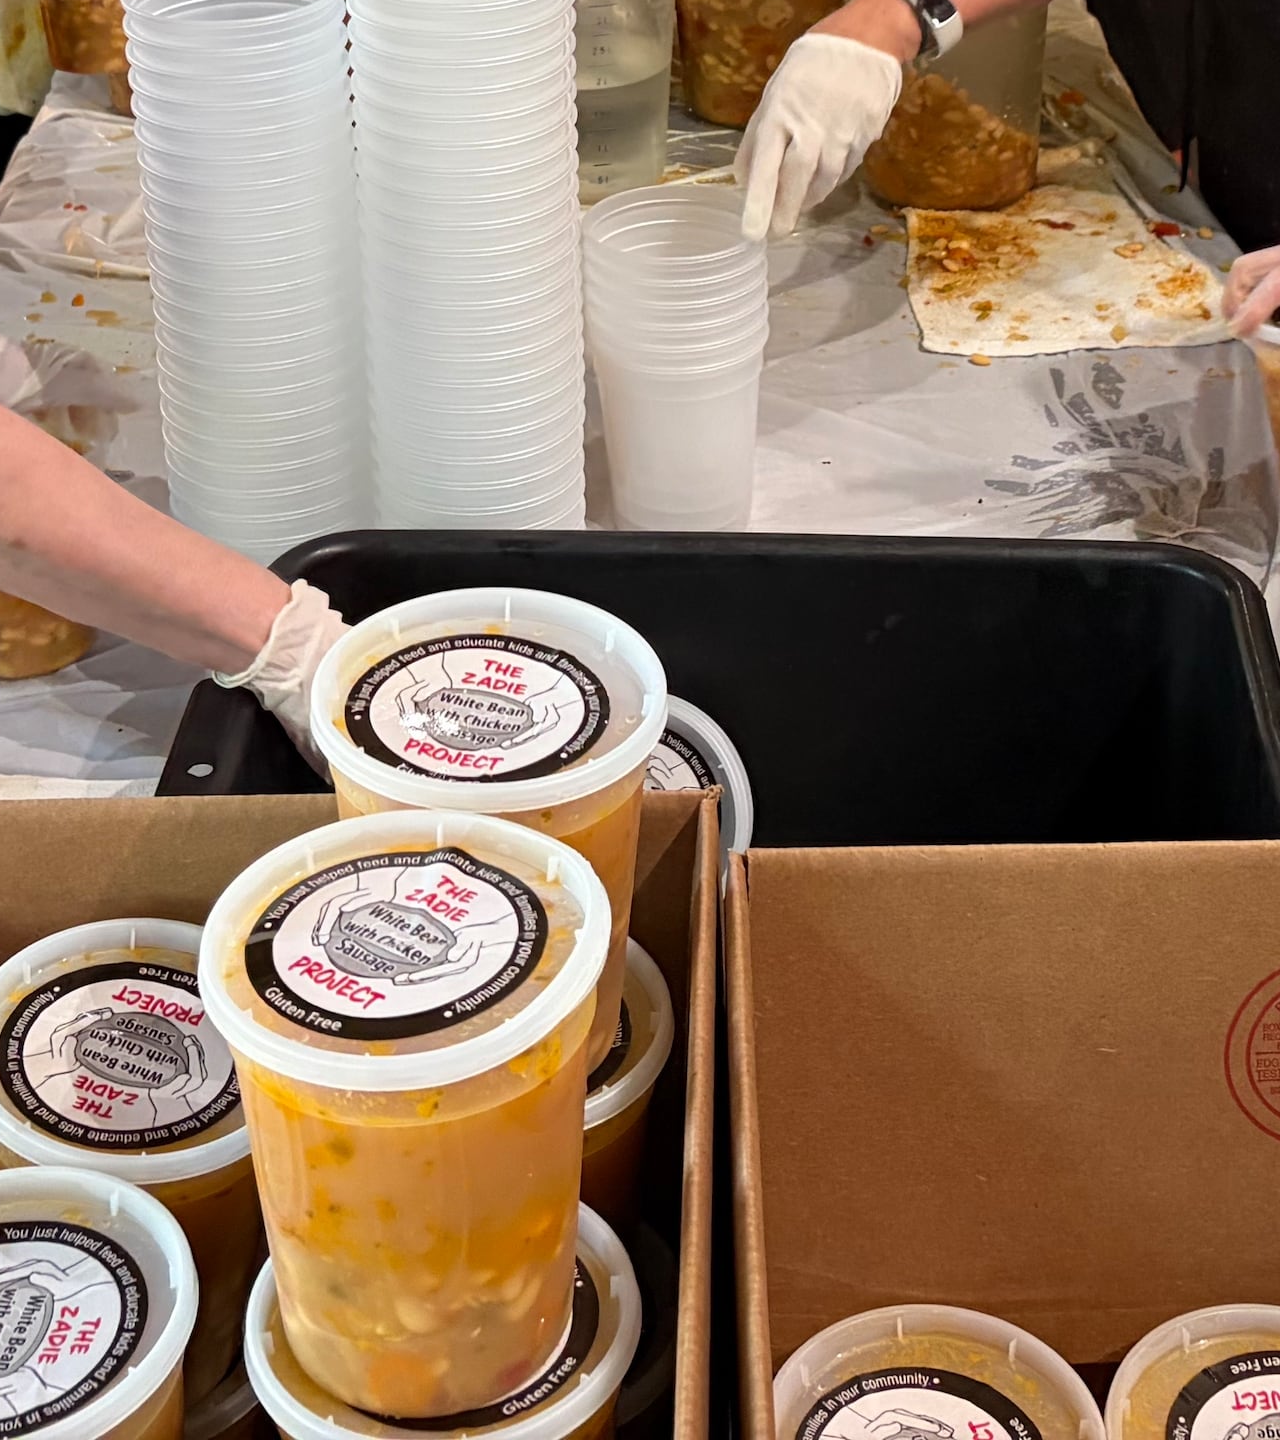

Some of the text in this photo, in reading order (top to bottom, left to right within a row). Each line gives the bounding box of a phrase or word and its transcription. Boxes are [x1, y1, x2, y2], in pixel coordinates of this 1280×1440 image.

[429, 638, 532, 655] and educate kids
[461, 672, 528, 695] ZADIE
[484, 659, 524, 678] THE
[440, 692, 525, 717] White Bean
[463, 714, 521, 732] Chicken
[404, 738, 504, 771] PROJECT
[267, 854, 502, 922] You helped and kids
[439, 875, 475, 904] THE
[368, 904, 410, 932] White
[405, 888, 470, 922] ZADIE
[344, 919, 378, 940] with
[335, 938, 396, 974] Sausage
[138, 966, 170, 980] Free
[288, 956, 386, 1010] PROJECT
[112, 985, 205, 1026] PROJECT
[265, 985, 342, 1032] Gluten Free
[89, 1028, 179, 1066] with Chicken
[116, 1018, 176, 1046] Sausage
[7, 990, 170, 1143] and educate kids your community.
[82, 1048, 164, 1084] White Bean
[72, 1074, 139, 1106] ZADIE
[72, 1095, 113, 1120] THE
[0, 1287, 18, 1315] with
[15, 1293, 48, 1330] White
[3, 1226, 102, 1418] You just helped families
[38, 1305, 80, 1365] ZADIE
[69, 1316, 102, 1356] THE
[1231, 1358, 1260, 1375] Free
[502, 1355, 578, 1418] Gluten Free
[826, 1372, 931, 1411] in your community.
